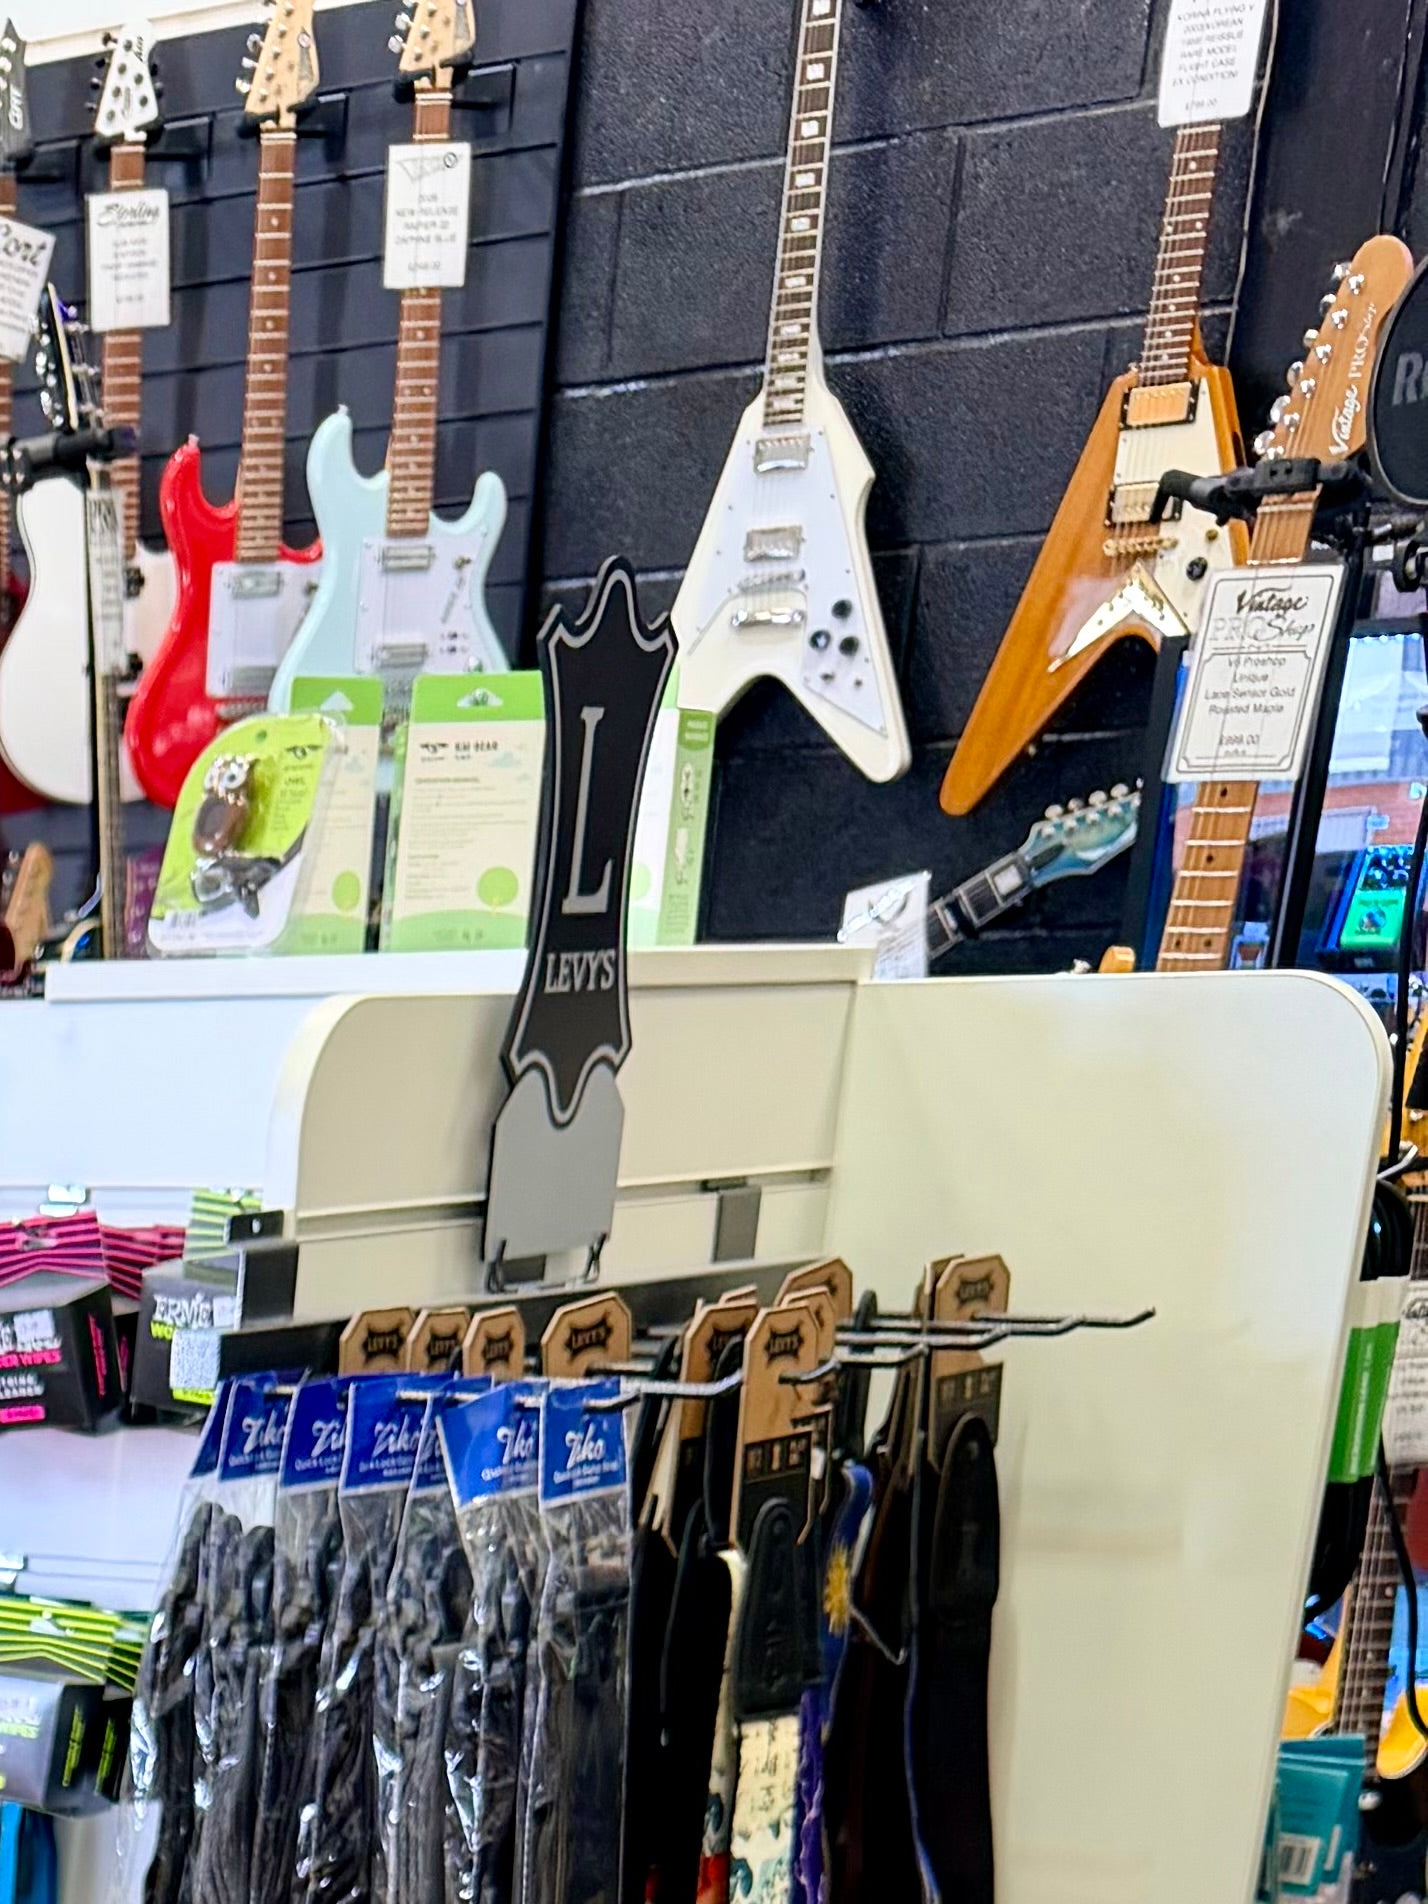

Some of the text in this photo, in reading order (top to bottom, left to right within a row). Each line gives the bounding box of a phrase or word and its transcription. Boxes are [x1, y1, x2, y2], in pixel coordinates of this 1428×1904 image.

[1235, 582, 1310, 616] Vintage
[561, 706, 614, 915] L
[543, 949, 617, 994] LEVY'S
[154, 1291, 213, 1331] ERNIE
[571, 1327, 607, 1348] LEVY'S
[20, 1349, 63, 1368] WIPES
